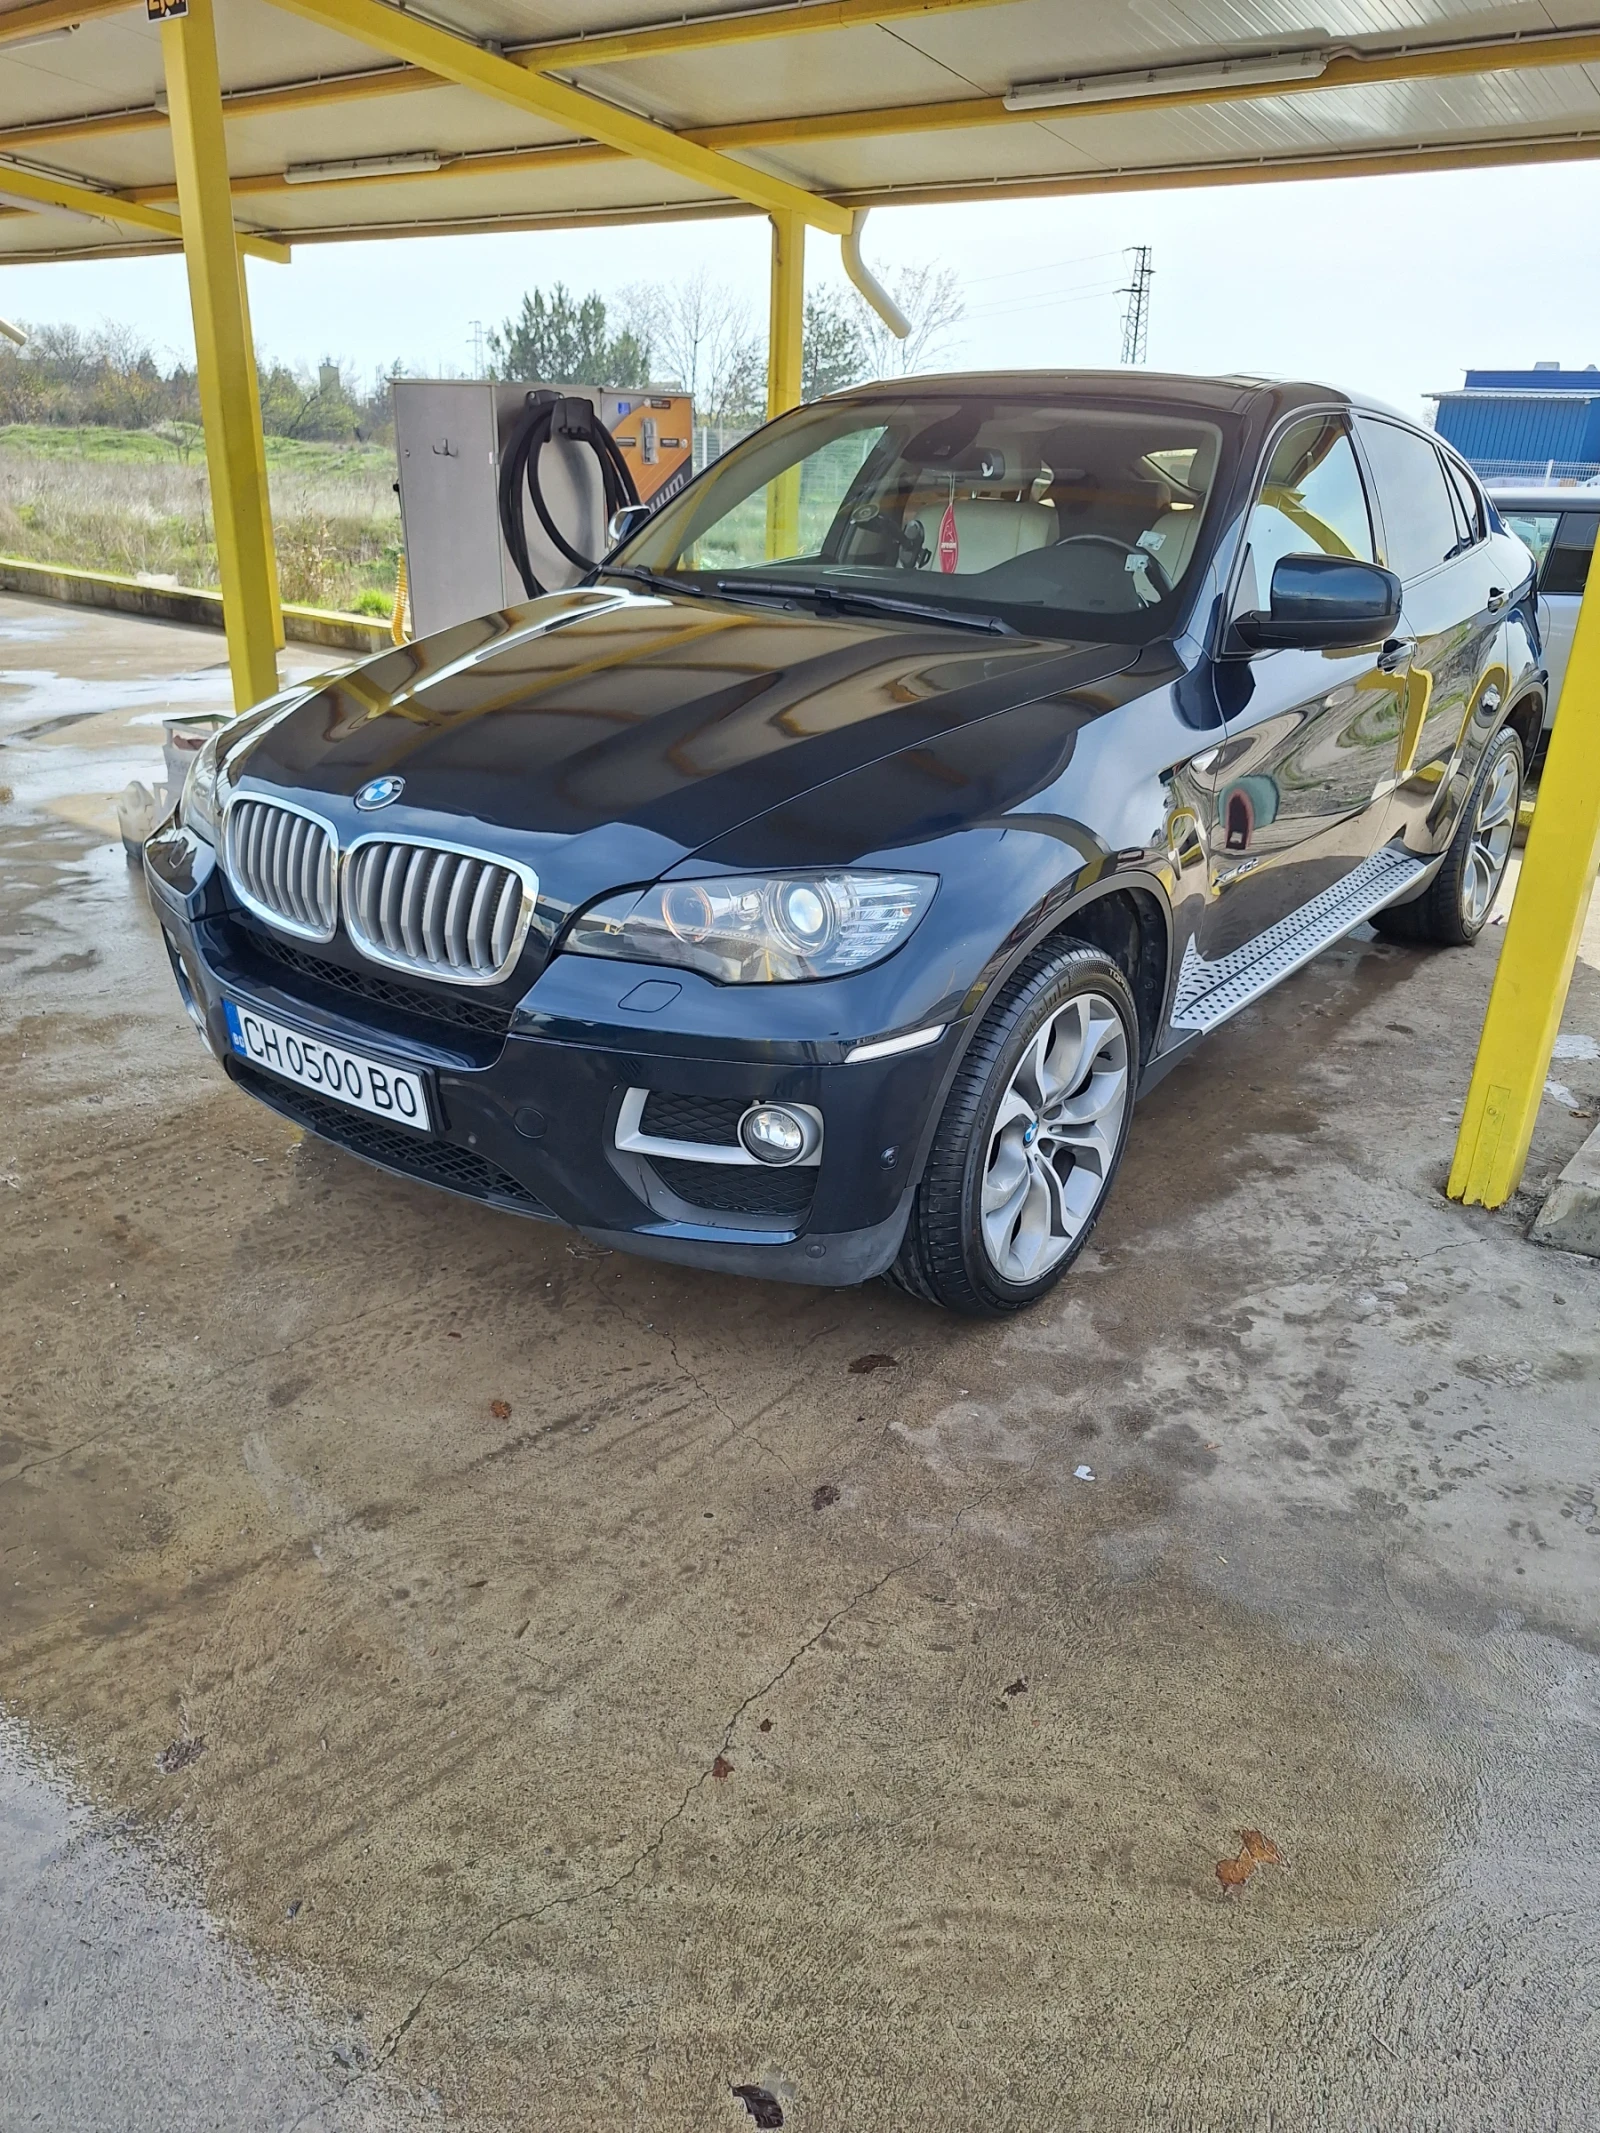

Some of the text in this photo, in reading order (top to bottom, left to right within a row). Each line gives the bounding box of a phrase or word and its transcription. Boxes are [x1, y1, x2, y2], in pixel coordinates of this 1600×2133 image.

[232, 1032, 245, 1048] BG
[243, 1016, 417, 1118] CH 0500 BO
